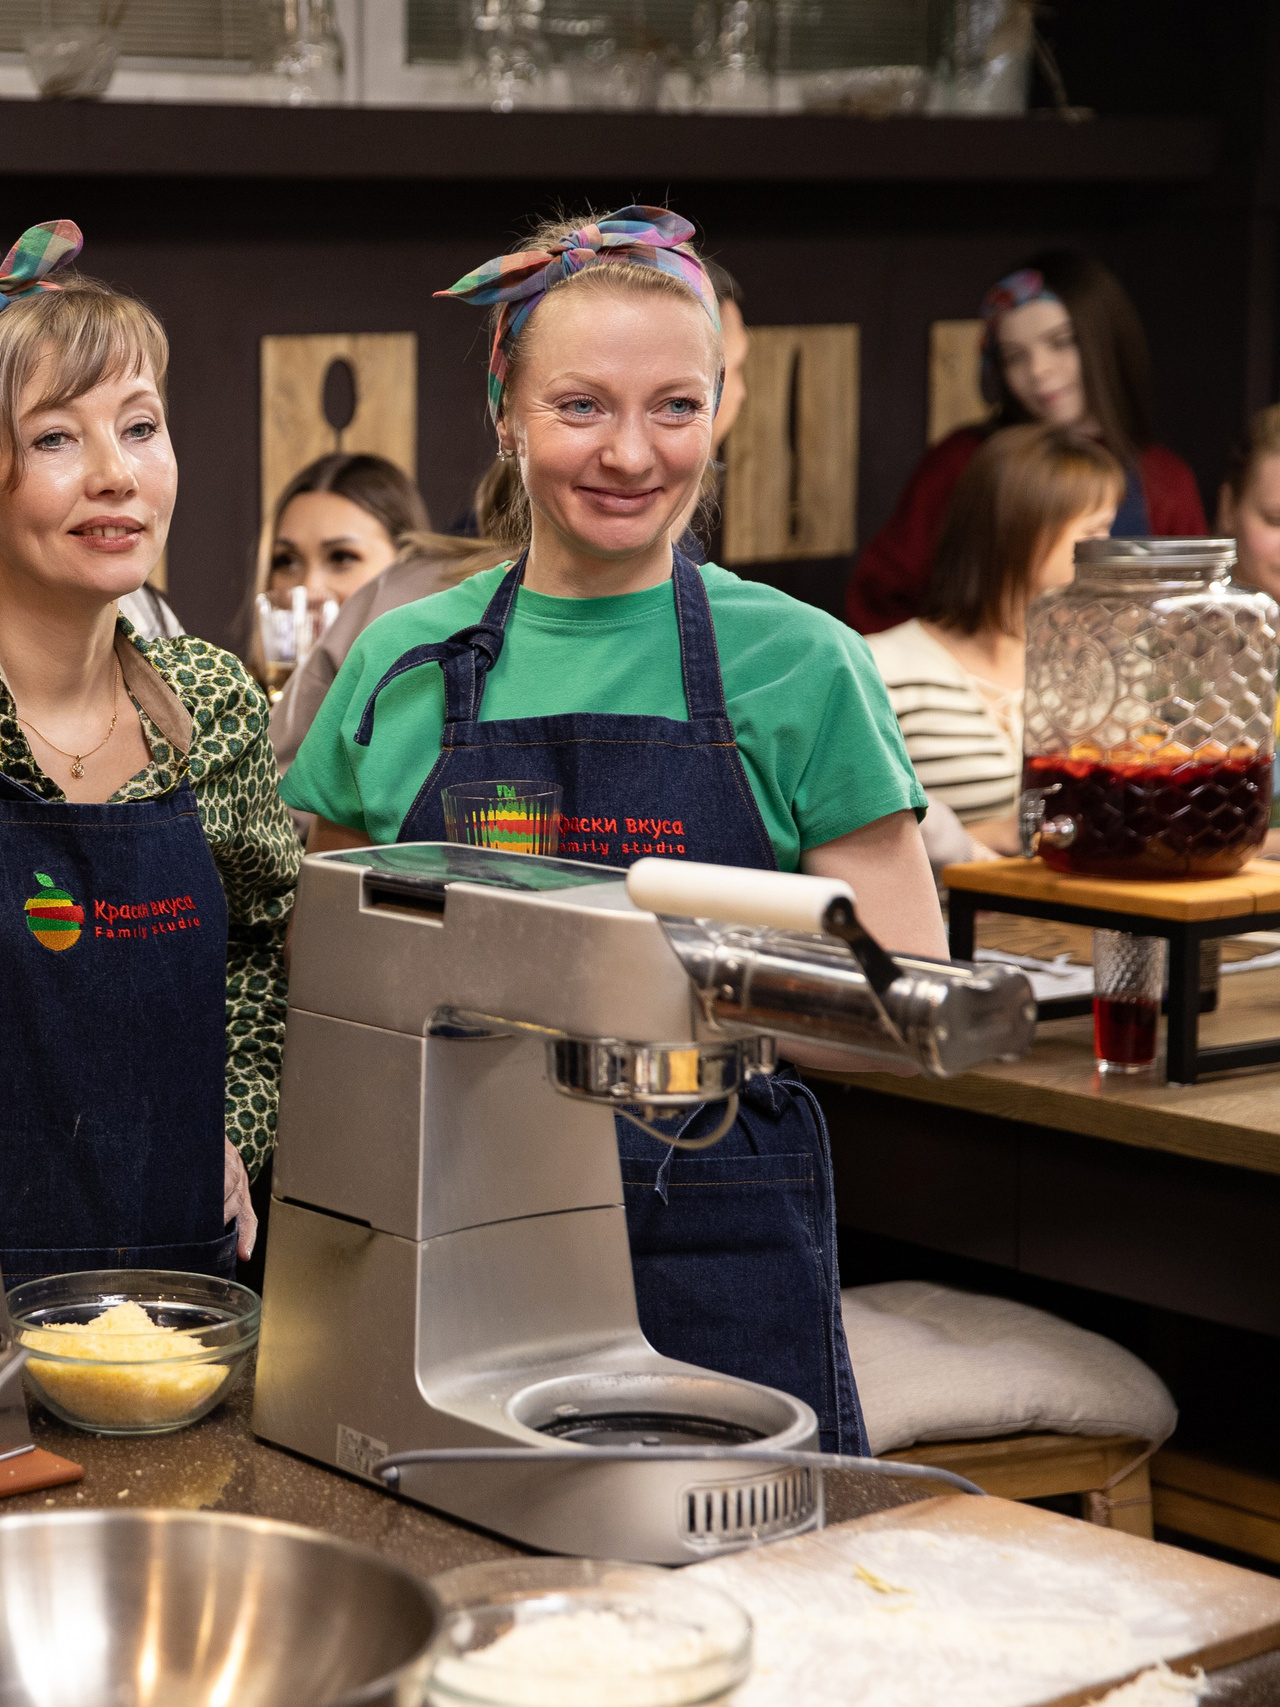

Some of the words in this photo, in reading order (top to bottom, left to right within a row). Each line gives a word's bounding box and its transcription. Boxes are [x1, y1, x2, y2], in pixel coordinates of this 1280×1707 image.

[559, 839, 610, 856] amily
[622, 841, 686, 855] studio
[94, 899, 149, 926] Краски
[94, 924, 148, 940] Family
[151, 917, 200, 935] studio
